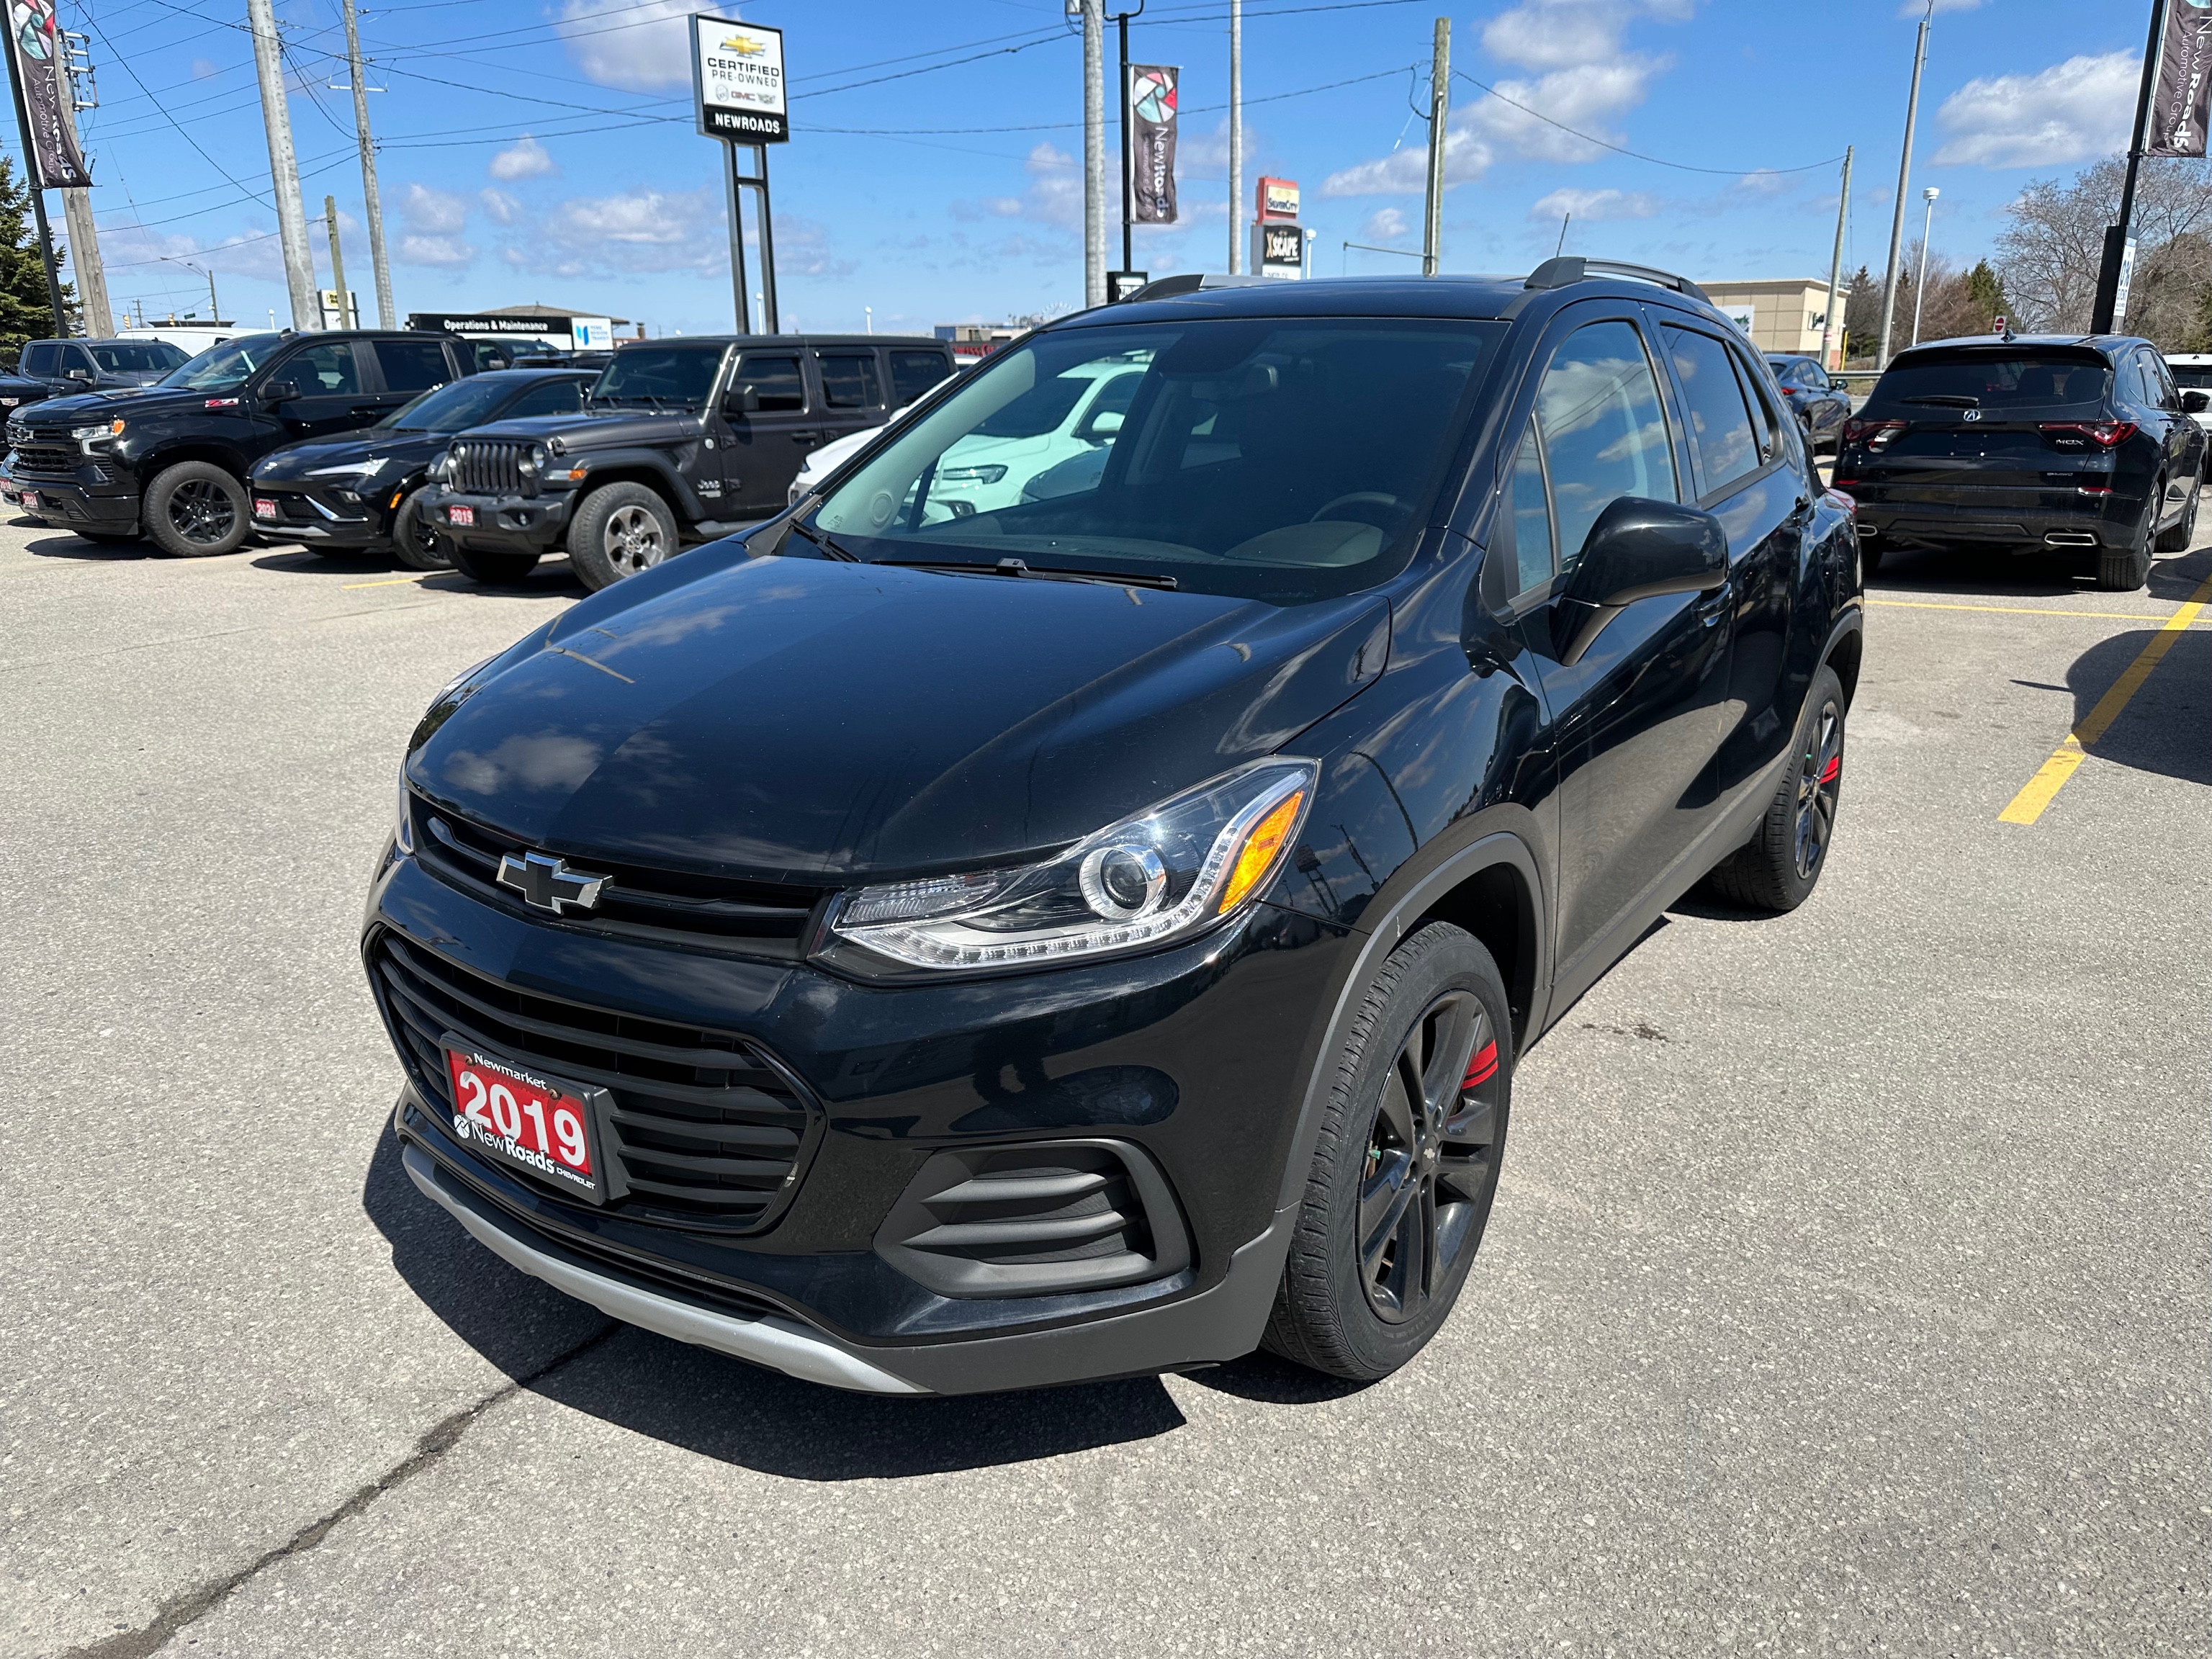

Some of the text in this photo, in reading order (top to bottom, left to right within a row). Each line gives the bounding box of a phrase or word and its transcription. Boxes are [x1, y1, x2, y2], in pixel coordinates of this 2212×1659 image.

[707, 57, 780, 77] CERTIFIED
[711, 69, 778, 88] PRE-OWNED
[2174, 30, 2193, 99] Automotive
[731, 91, 756, 102] GMC
[2174, 16, 2212, 148] NewRoads
[32, 78, 50, 139] Automotive
[714, 112, 781, 135] NEWROADS
[444, 319, 548, 331] Operations & Maintenance
[450, 508, 473, 523] 2019
[473, 1052, 547, 1090] Newmarket
[459, 1070, 585, 1166] 2019
[471, 1120, 595, 1190] NewRoads CHEVROLET
